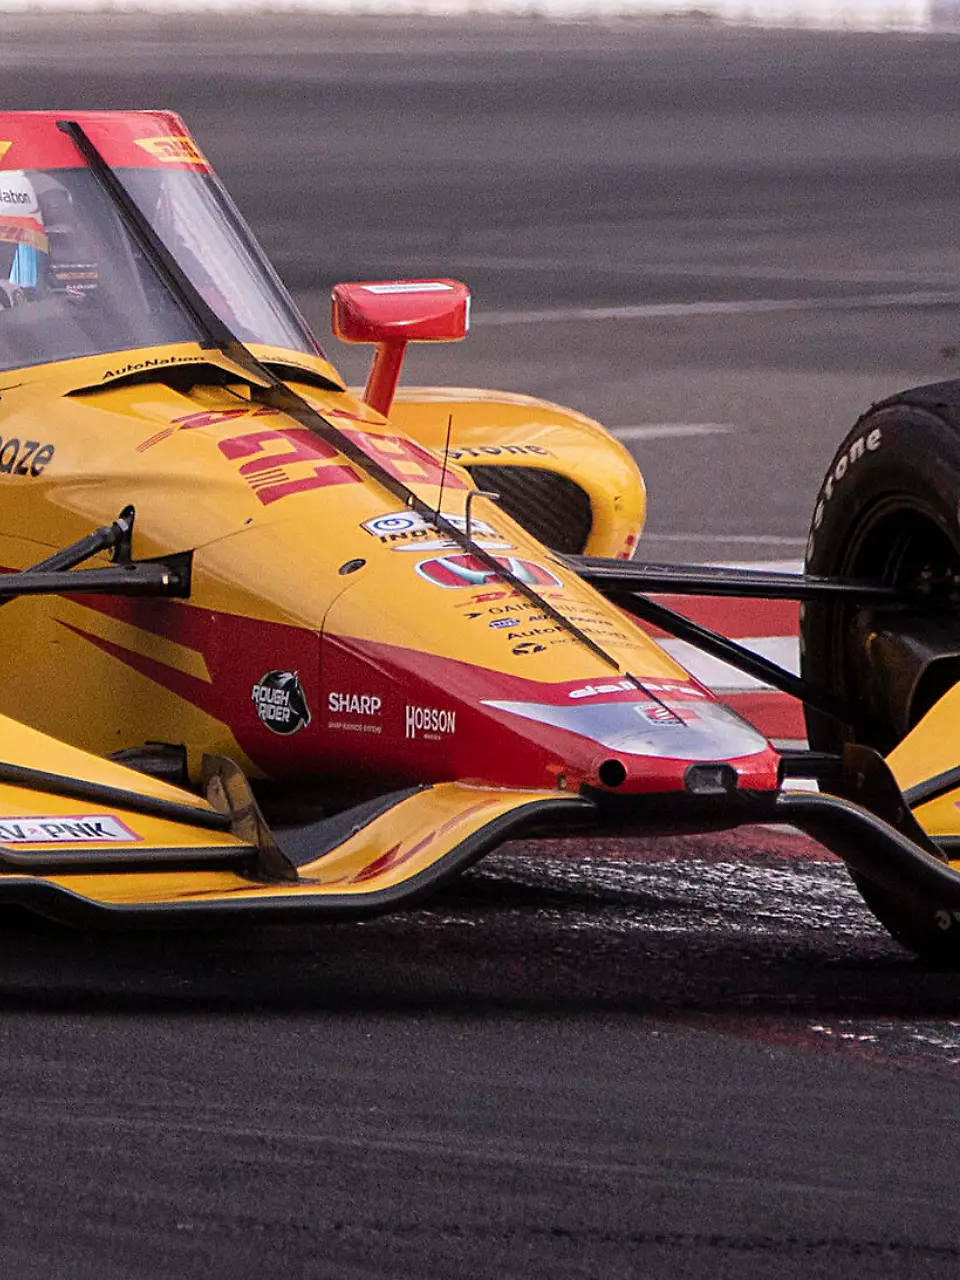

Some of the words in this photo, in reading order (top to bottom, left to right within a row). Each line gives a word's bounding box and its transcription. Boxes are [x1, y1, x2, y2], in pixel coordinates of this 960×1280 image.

[102, 355, 207, 380] AutoNation
[251, 684, 290, 706] ROUGH
[569, 681, 704, 699] dallara
[257, 703, 291, 723] RIDER
[328, 691, 382, 716] SHARP
[405, 705, 456, 739] HOBSON
[41, 822, 117, 839] PNK
